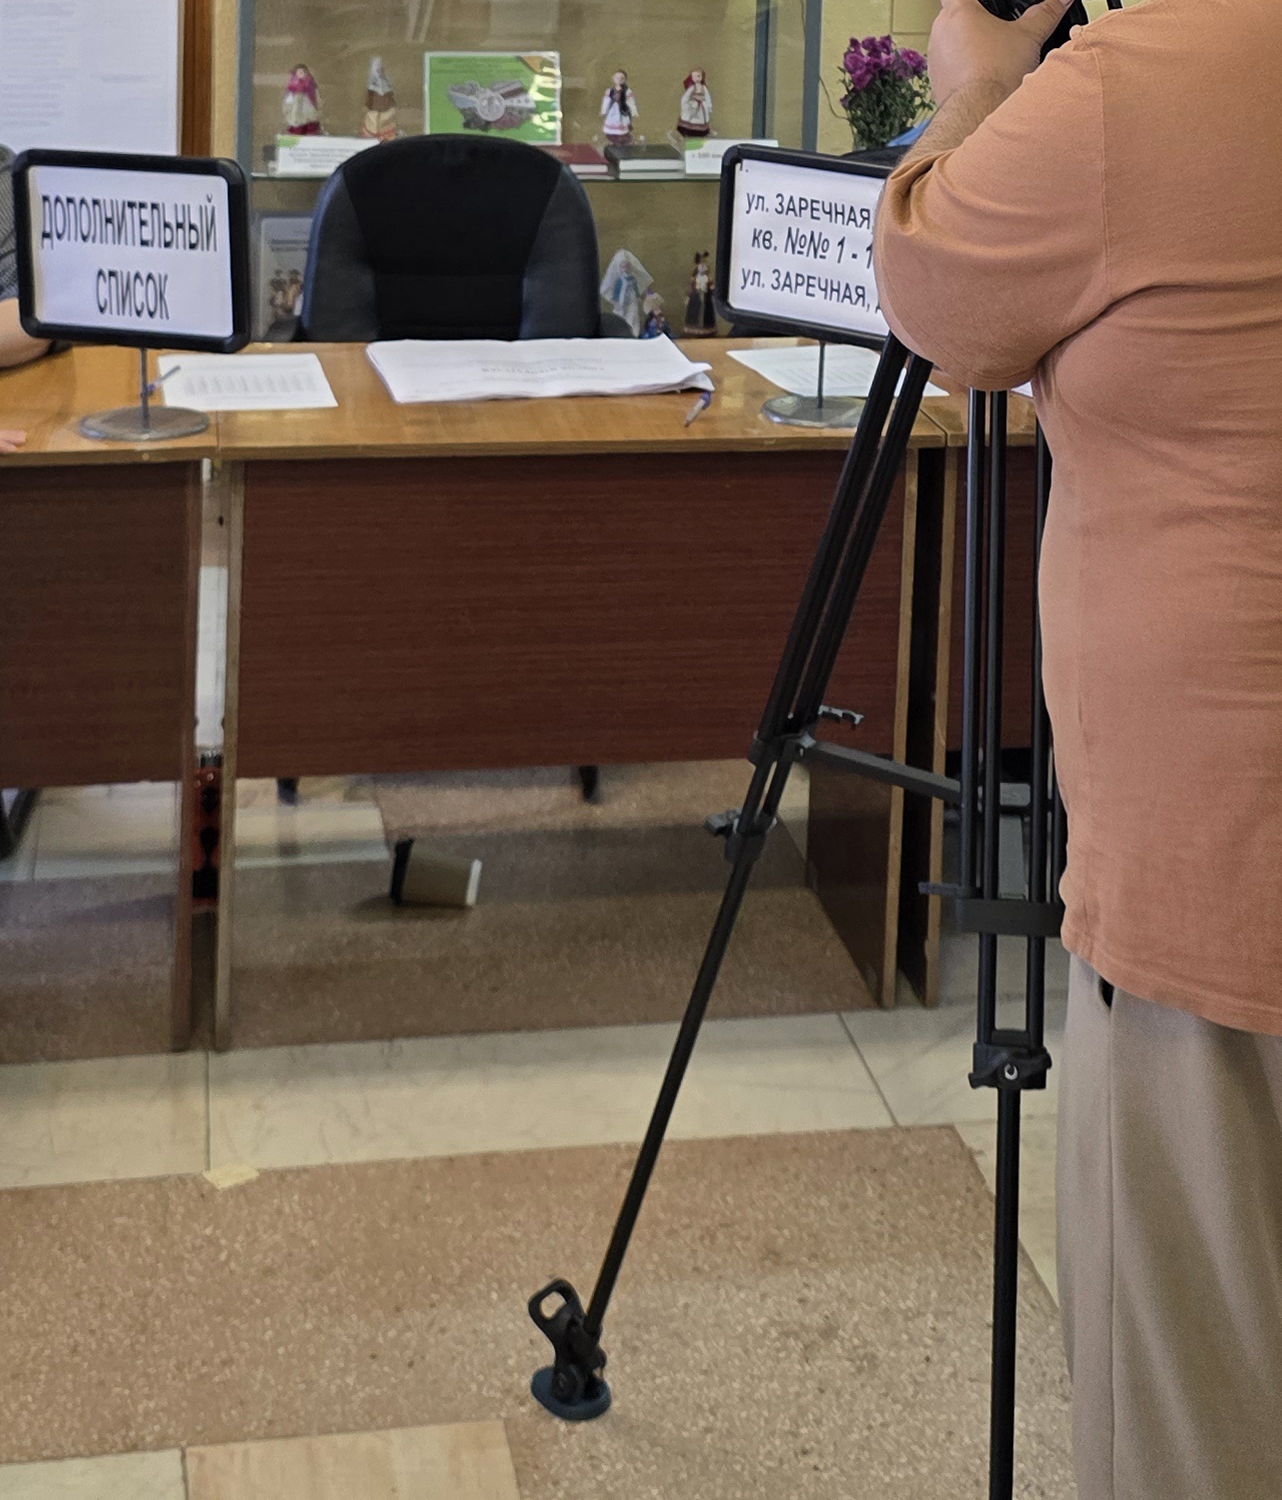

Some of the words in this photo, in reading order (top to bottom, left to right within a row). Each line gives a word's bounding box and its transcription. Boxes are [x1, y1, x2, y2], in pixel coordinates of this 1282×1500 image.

[41, 193, 218, 252] ДОПОЛНИТЕЛЬНЫЙ
[746, 192, 770, 214] ул.
[775, 193, 872, 230] ЗАРЕЧНАЯ
[751, 228, 778, 252] кв.
[784, 226, 830, 260] №№
[837, 236, 846, 264] 1
[865, 244, 874, 269] 1
[96, 268, 170, 320] СПИСОК
[741, 268, 766, 291] ул.
[771, 269, 871, 312] ЗАРЕЧНАЯ,
